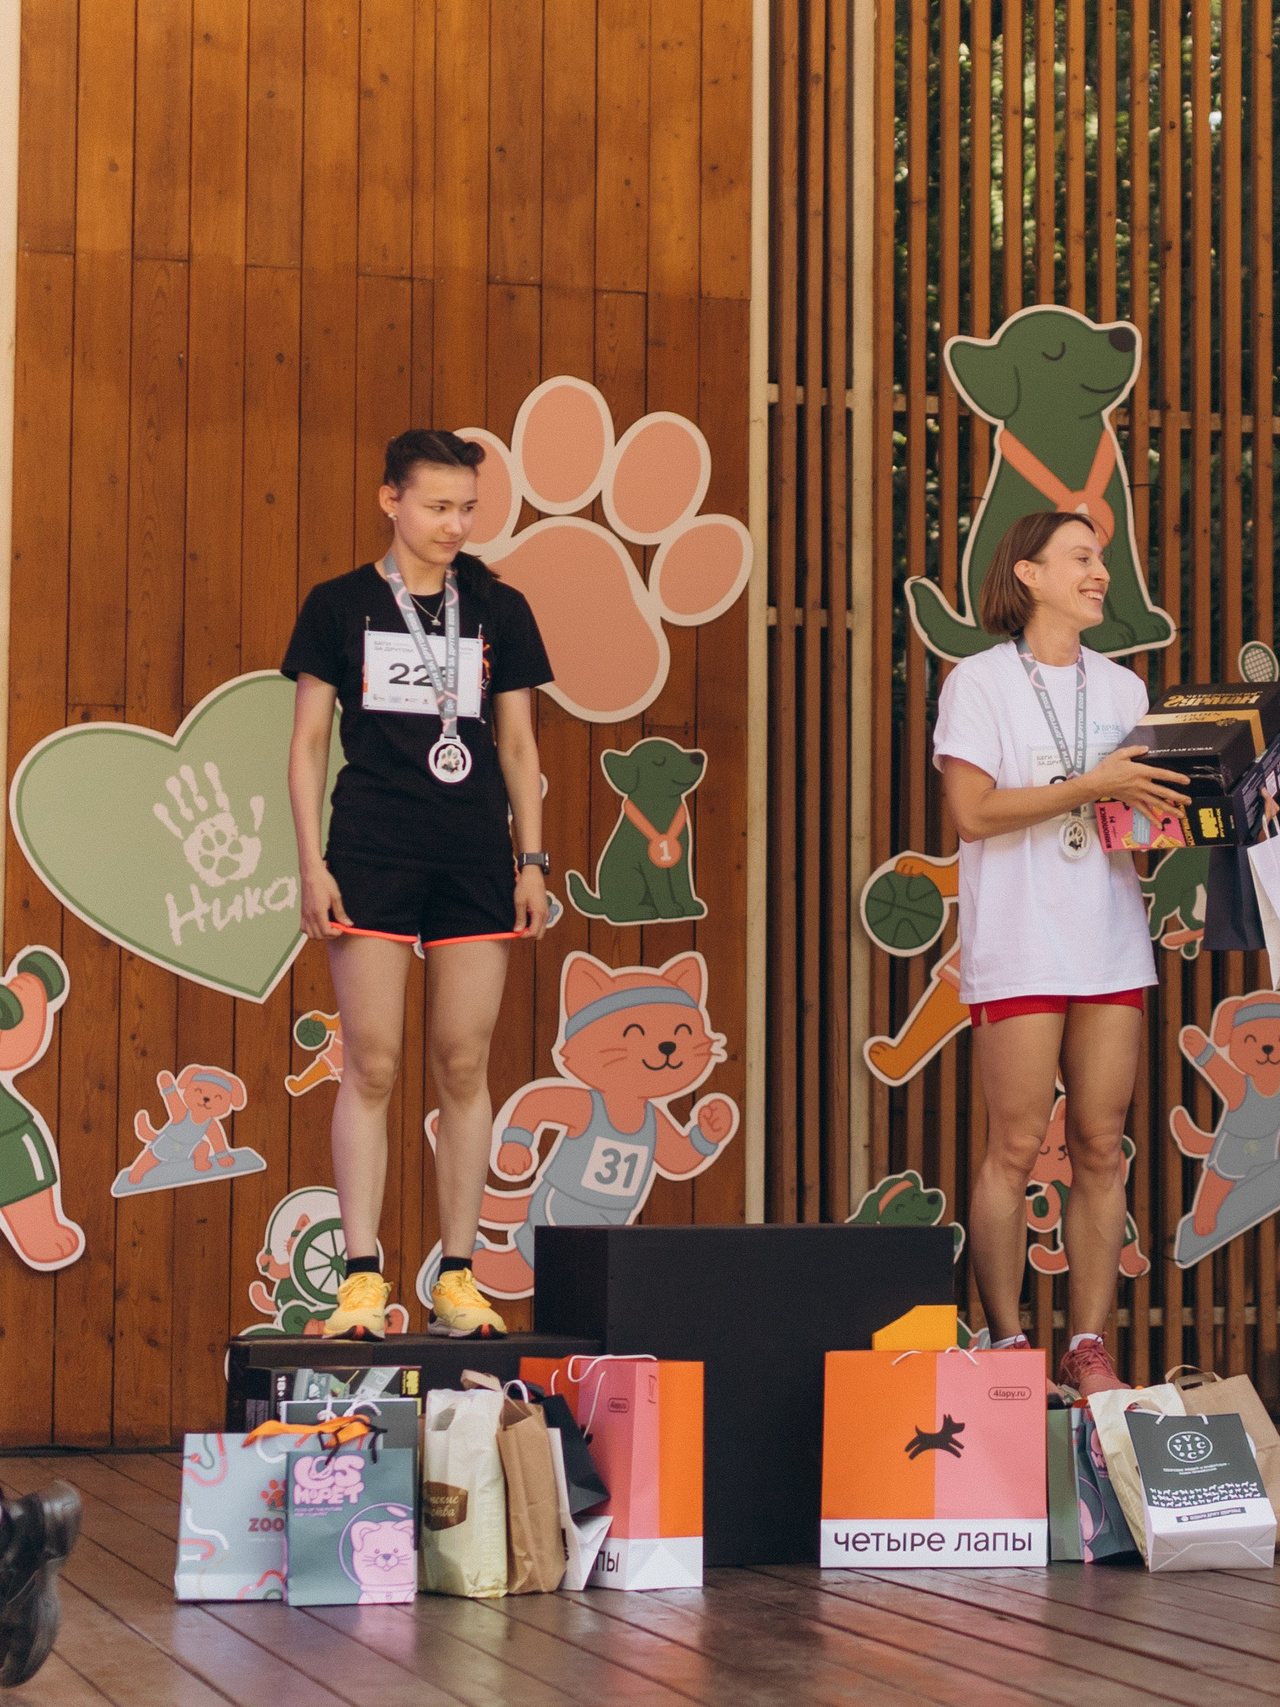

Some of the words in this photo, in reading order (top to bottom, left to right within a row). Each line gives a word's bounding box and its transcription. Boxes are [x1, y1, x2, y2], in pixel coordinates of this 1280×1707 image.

[660, 840, 672, 862] 1
[594, 1147, 638, 1190] 31
[992, 1389, 1026, 1399] 4lapy.ru
[833, 1531, 946, 1553] четыре
[953, 1531, 1033, 1553] лапы
[594, 1550, 620, 1573] пы
